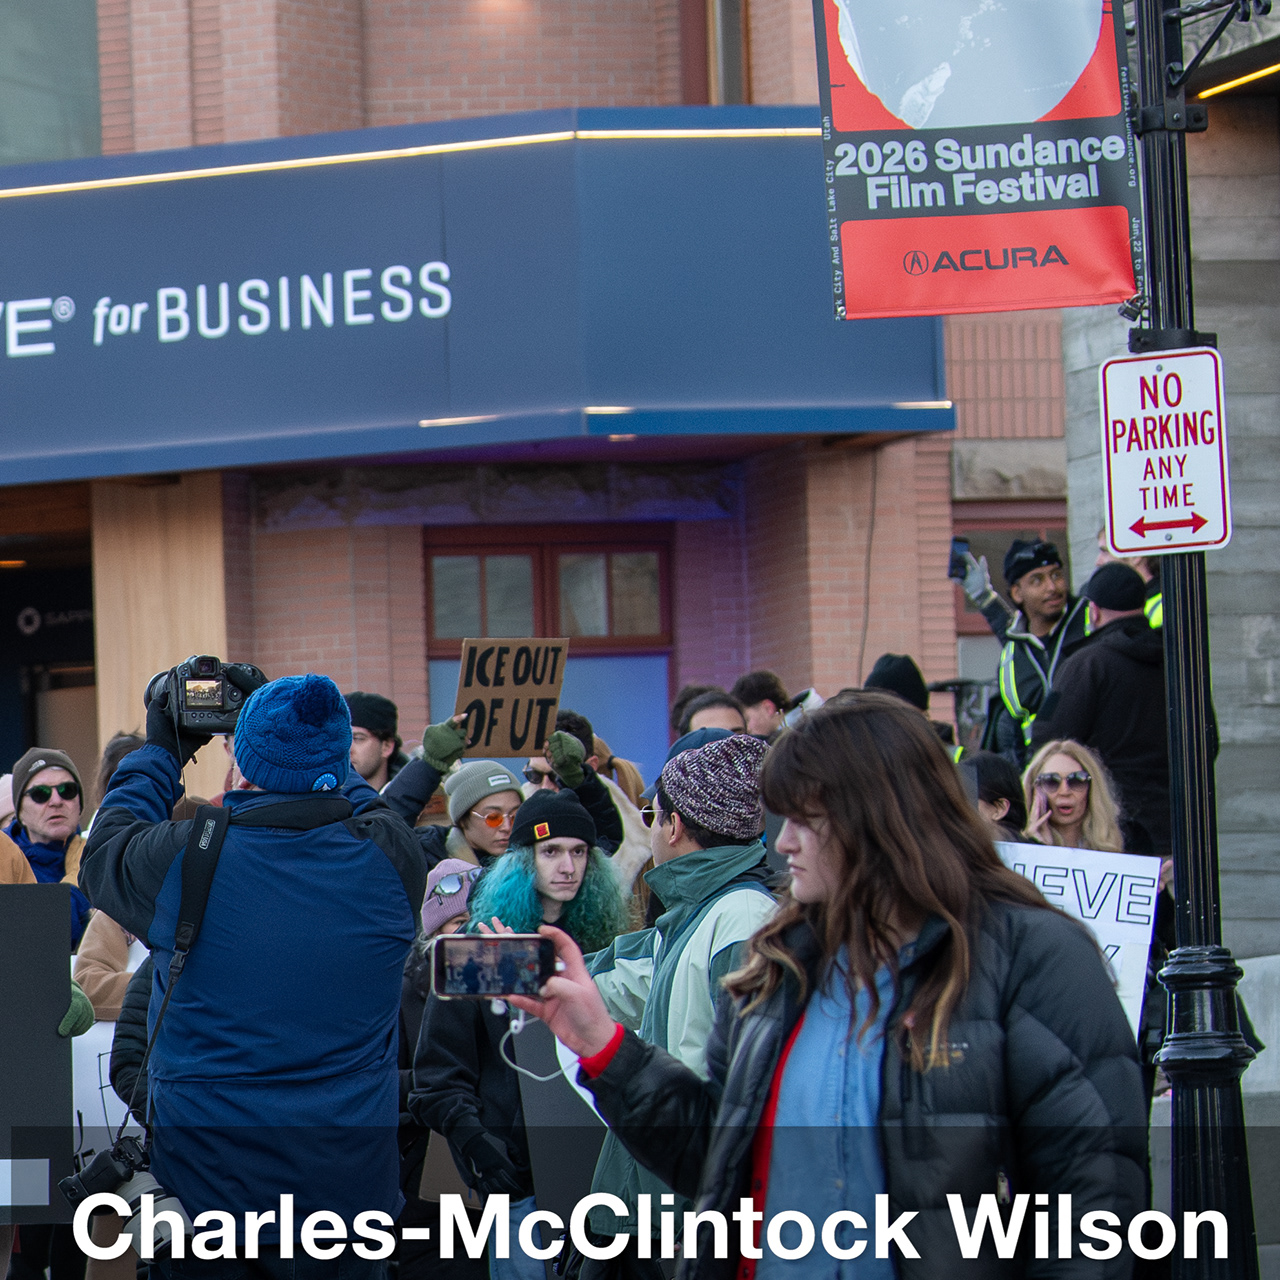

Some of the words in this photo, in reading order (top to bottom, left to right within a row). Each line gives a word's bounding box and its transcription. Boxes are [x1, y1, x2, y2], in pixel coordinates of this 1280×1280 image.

[823, 116, 832, 140] Utah
[834, 139, 928, 177] 2026
[935, 133, 1126, 172] Sundance
[826, 159, 835, 183] City
[828, 189, 837, 212] Lake
[867, 176, 946, 210] Film
[954, 165, 1100, 206] Festival
[829, 218, 839, 241] Salt
[831, 246, 841, 264] And
[931, 244, 1070, 273] ACURA
[833, 270, 842, 293] City
[93, 297, 149, 345] for
[156, 260, 453, 344] BUSINESS
[1139, 373, 1183, 409] NO
[1112, 410, 1215, 454] PARKING
[1143, 456, 1188, 482] ANY
[1139, 484, 1195, 510] TIME
[463, 645, 507, 688] ICE
[512, 644, 562, 688] OUT
[461, 697, 508, 751] OF
[510, 696, 559, 751] UT
[1014, 862, 1156, 926] EVE
